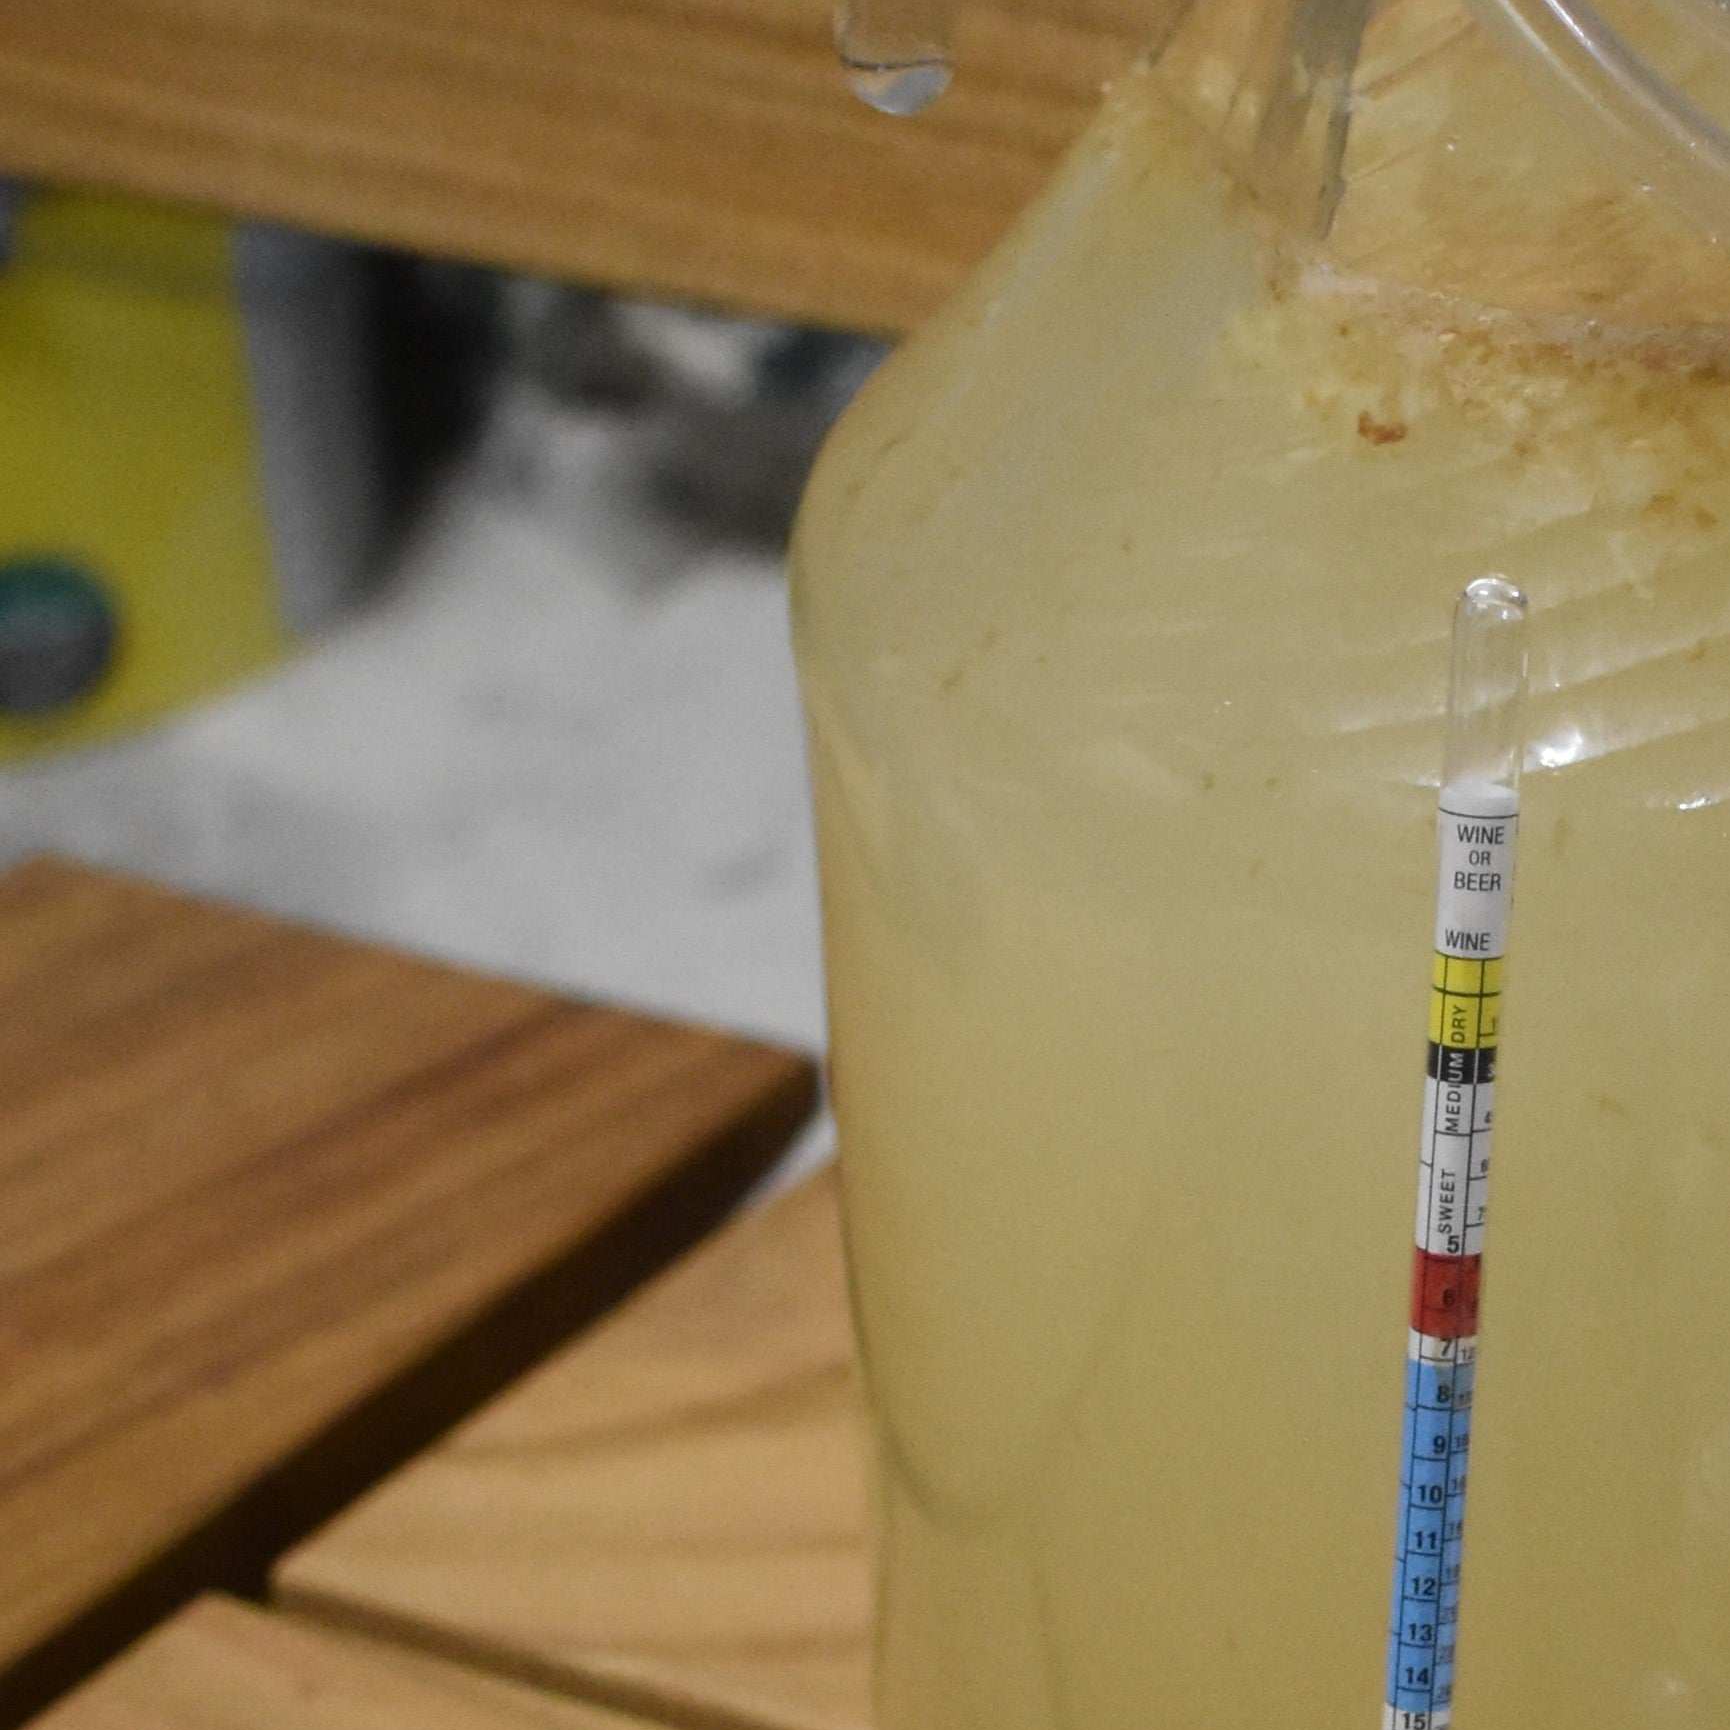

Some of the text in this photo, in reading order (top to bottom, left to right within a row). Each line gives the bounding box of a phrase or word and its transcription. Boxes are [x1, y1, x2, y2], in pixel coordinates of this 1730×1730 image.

[1456, 823, 1505, 845] WINE
[1468, 849, 1492, 867] OR
[1453, 871, 1502, 893] BEER
[1444, 928, 1491, 952] WINE
[1451, 1004, 1467, 1044] DRY
[1445, 1051, 1465, 1133] MEDIUM
[1437, 1168, 1457, 1235] SWEET
[1446, 1235, 1460, 1253] 5
[1442, 1286, 1455, 1305] 6
[1440, 1337, 1455, 1357] 7
[1436, 1383, 1451, 1403] 8
[1432, 1434, 1447, 1454] 9
[1416, 1483, 1443, 1504] 10
[1414, 1529, 1438, 1550] 11
[1410, 1576, 1437, 1597] 12
[1408, 1623, 1433, 1642] 13
[1404, 1666, 1430, 1686] 14
[1401, 1711, 1427, 1730] 15
